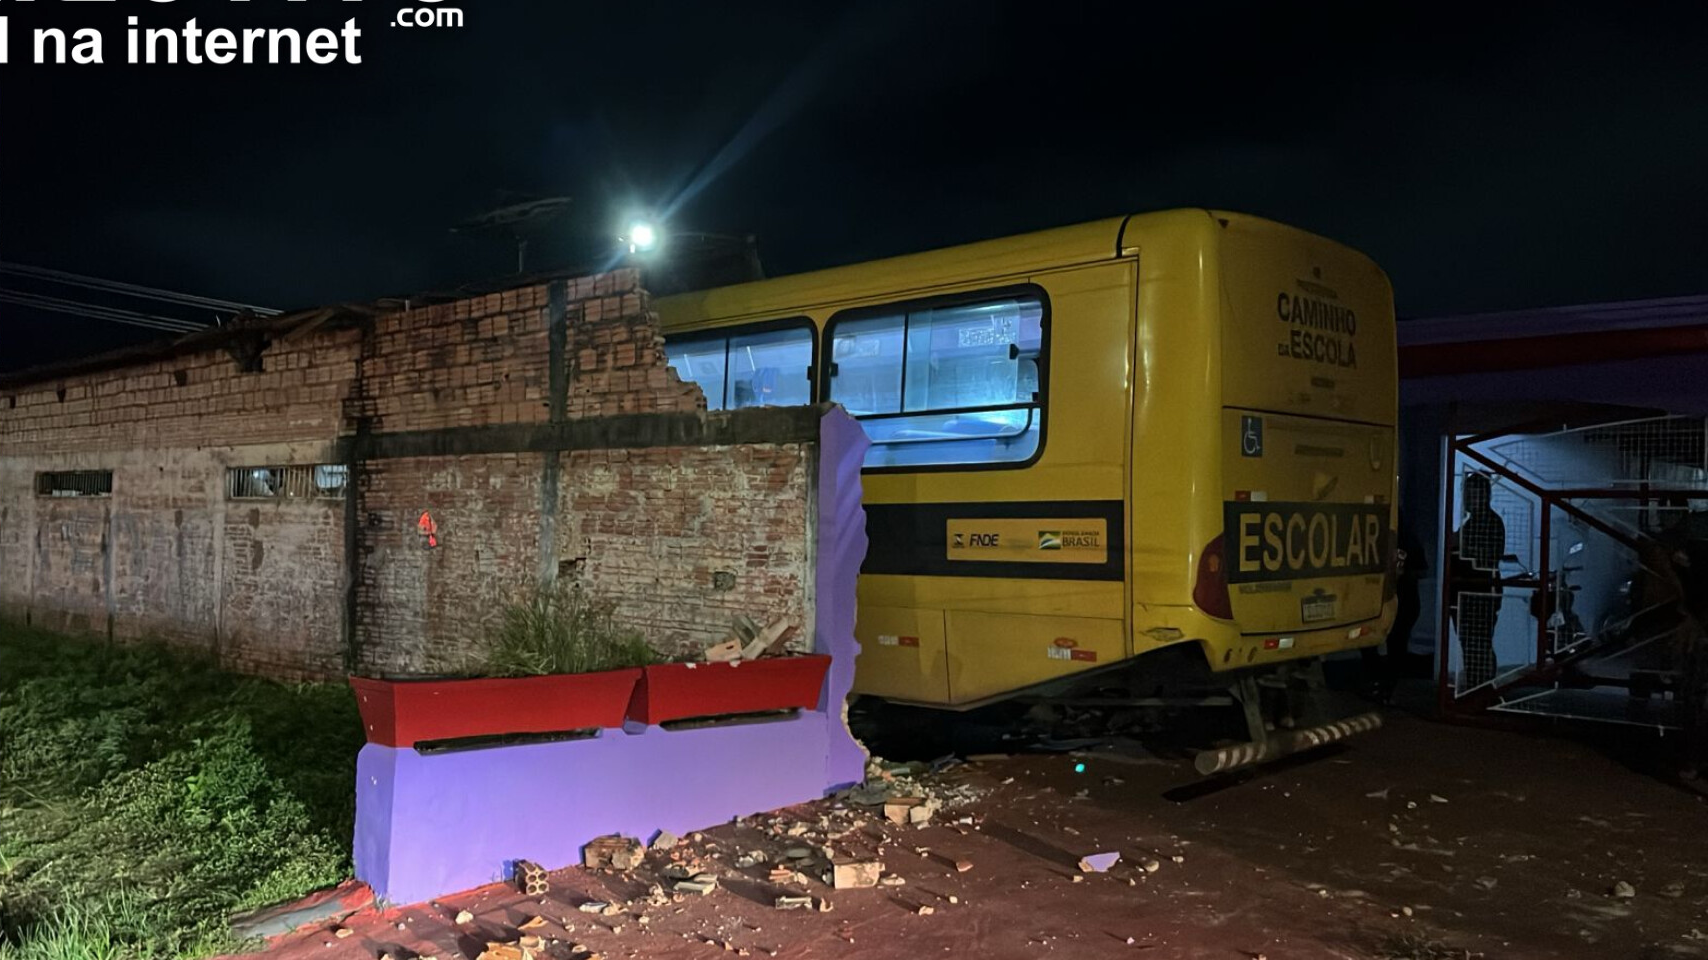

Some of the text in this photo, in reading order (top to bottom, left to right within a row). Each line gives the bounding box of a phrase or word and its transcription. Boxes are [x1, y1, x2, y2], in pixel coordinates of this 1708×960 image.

[1277, 291, 1357, 338] CAMINHO
[1290, 329, 1357, 370] ESCOLA
[969, 533, 1000, 547] FNDE
[1062, 537, 1100, 547] BRASIL
[1238, 511, 1381, 572] ESCOLAR
